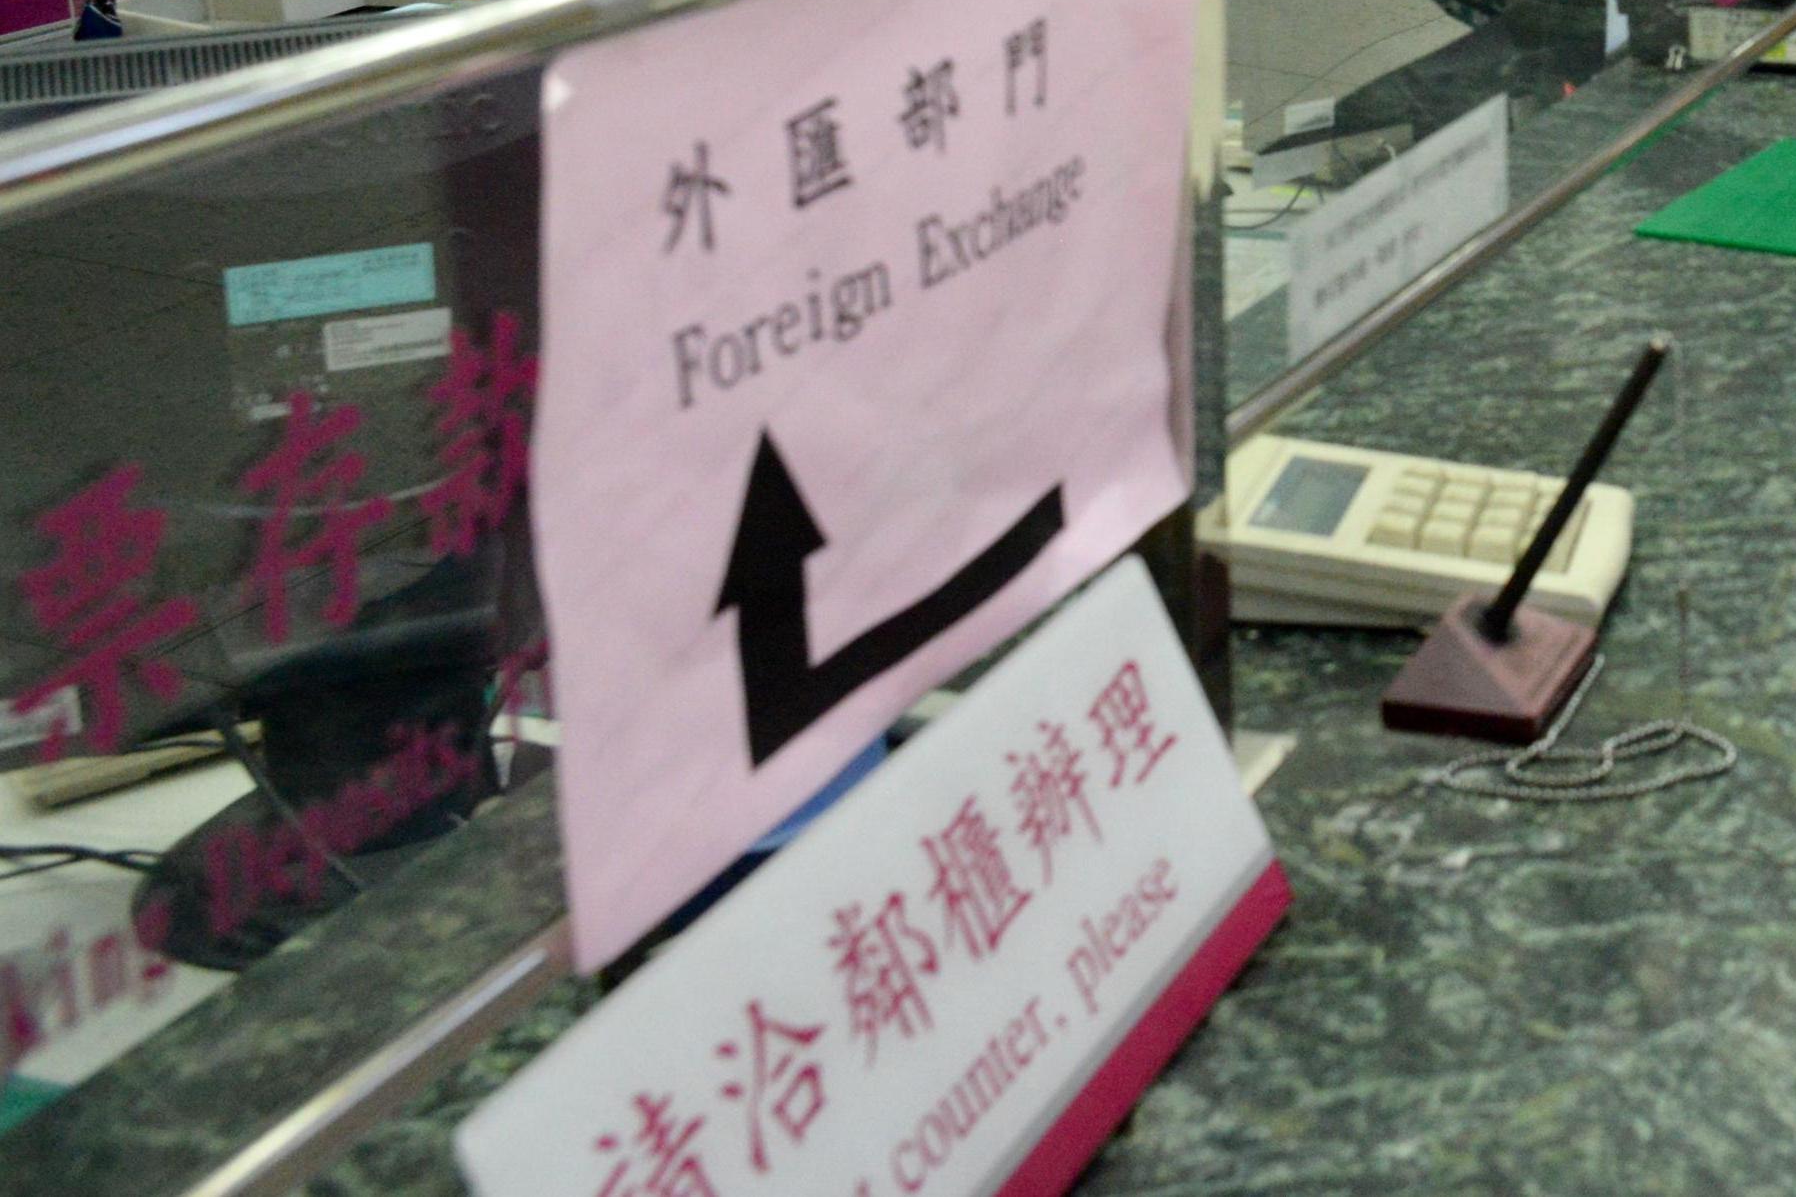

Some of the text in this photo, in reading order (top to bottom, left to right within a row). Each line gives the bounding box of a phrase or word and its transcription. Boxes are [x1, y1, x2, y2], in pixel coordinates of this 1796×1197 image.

[659, 16, 1049, 253] 外匯部門
[672, 155, 1087, 409] Foreign Exchange
[1064, 856, 1182, 1017] please
